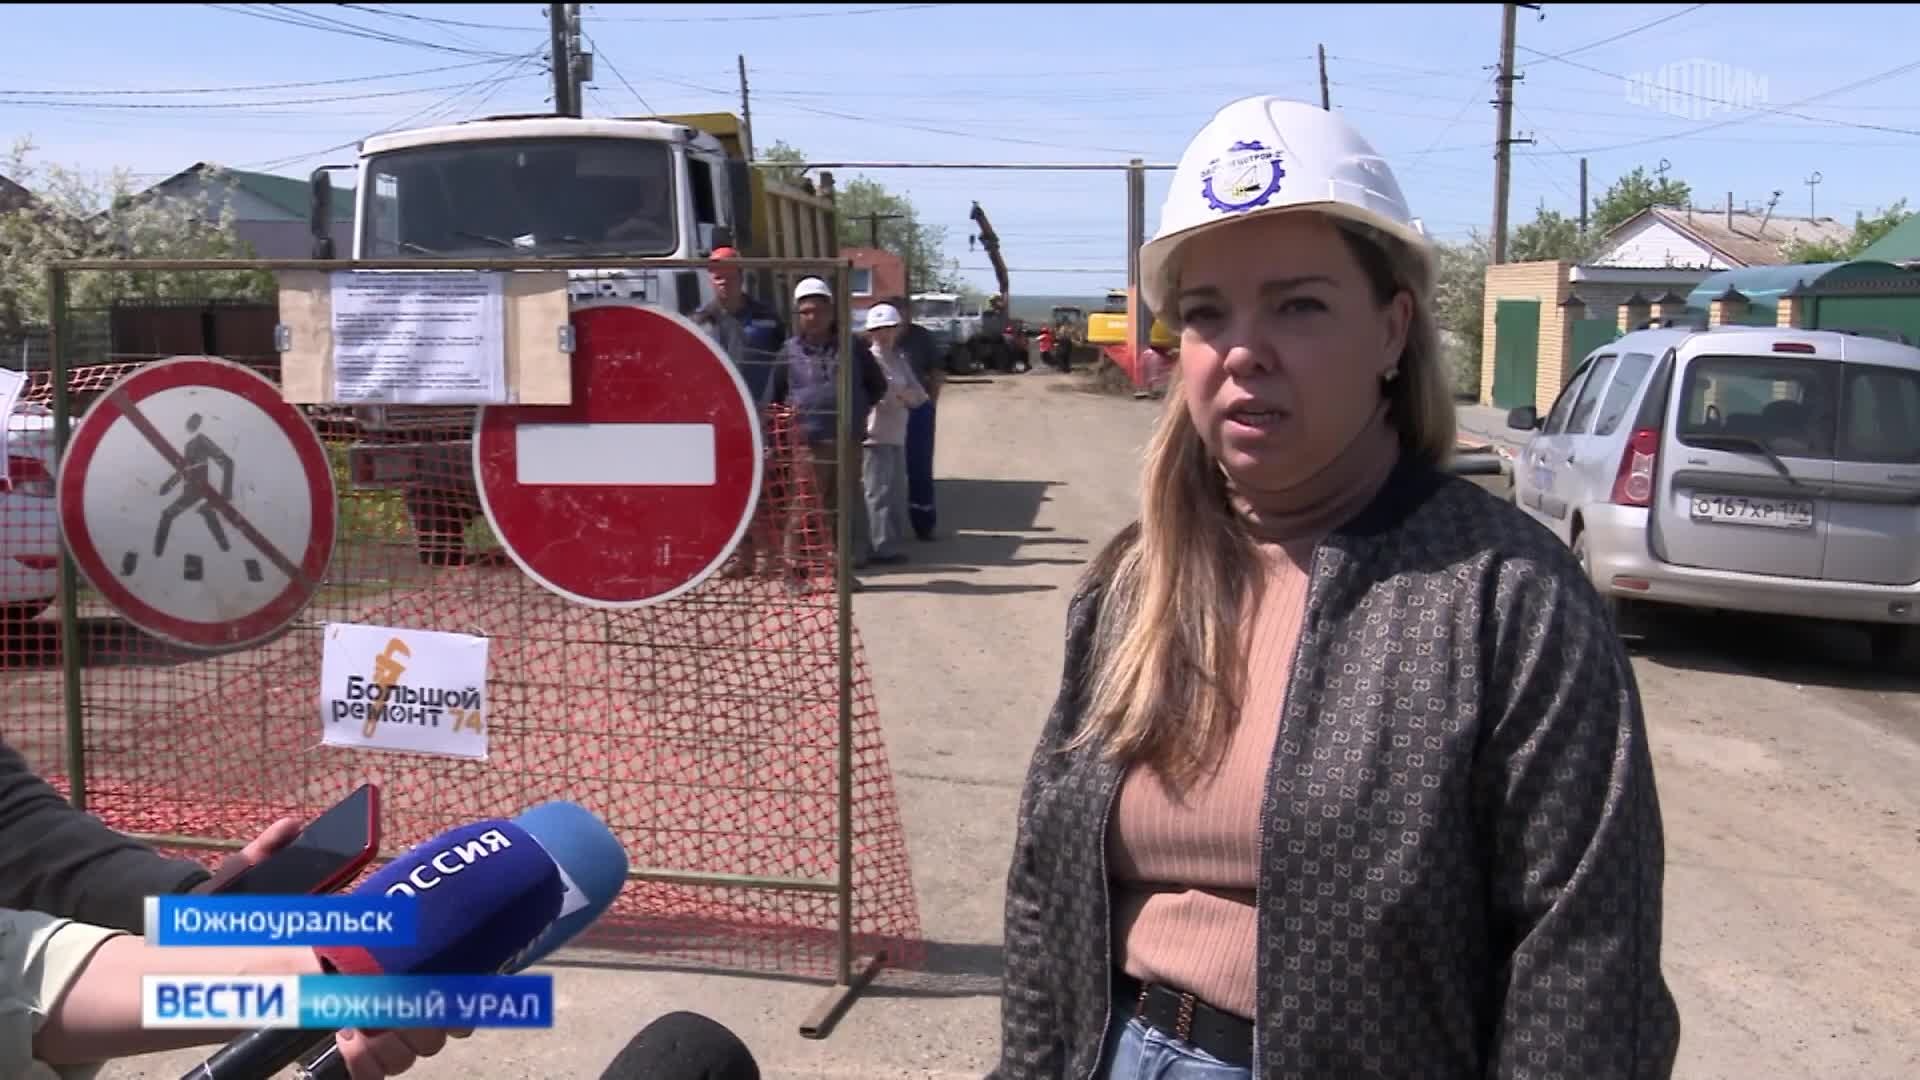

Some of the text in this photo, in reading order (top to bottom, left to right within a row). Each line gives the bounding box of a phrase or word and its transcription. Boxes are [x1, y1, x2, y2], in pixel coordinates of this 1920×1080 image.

[346, 675, 481, 710] Большой
[331, 699, 484, 734] ремонт 74
[385, 829, 512, 897] ОССИЯ
